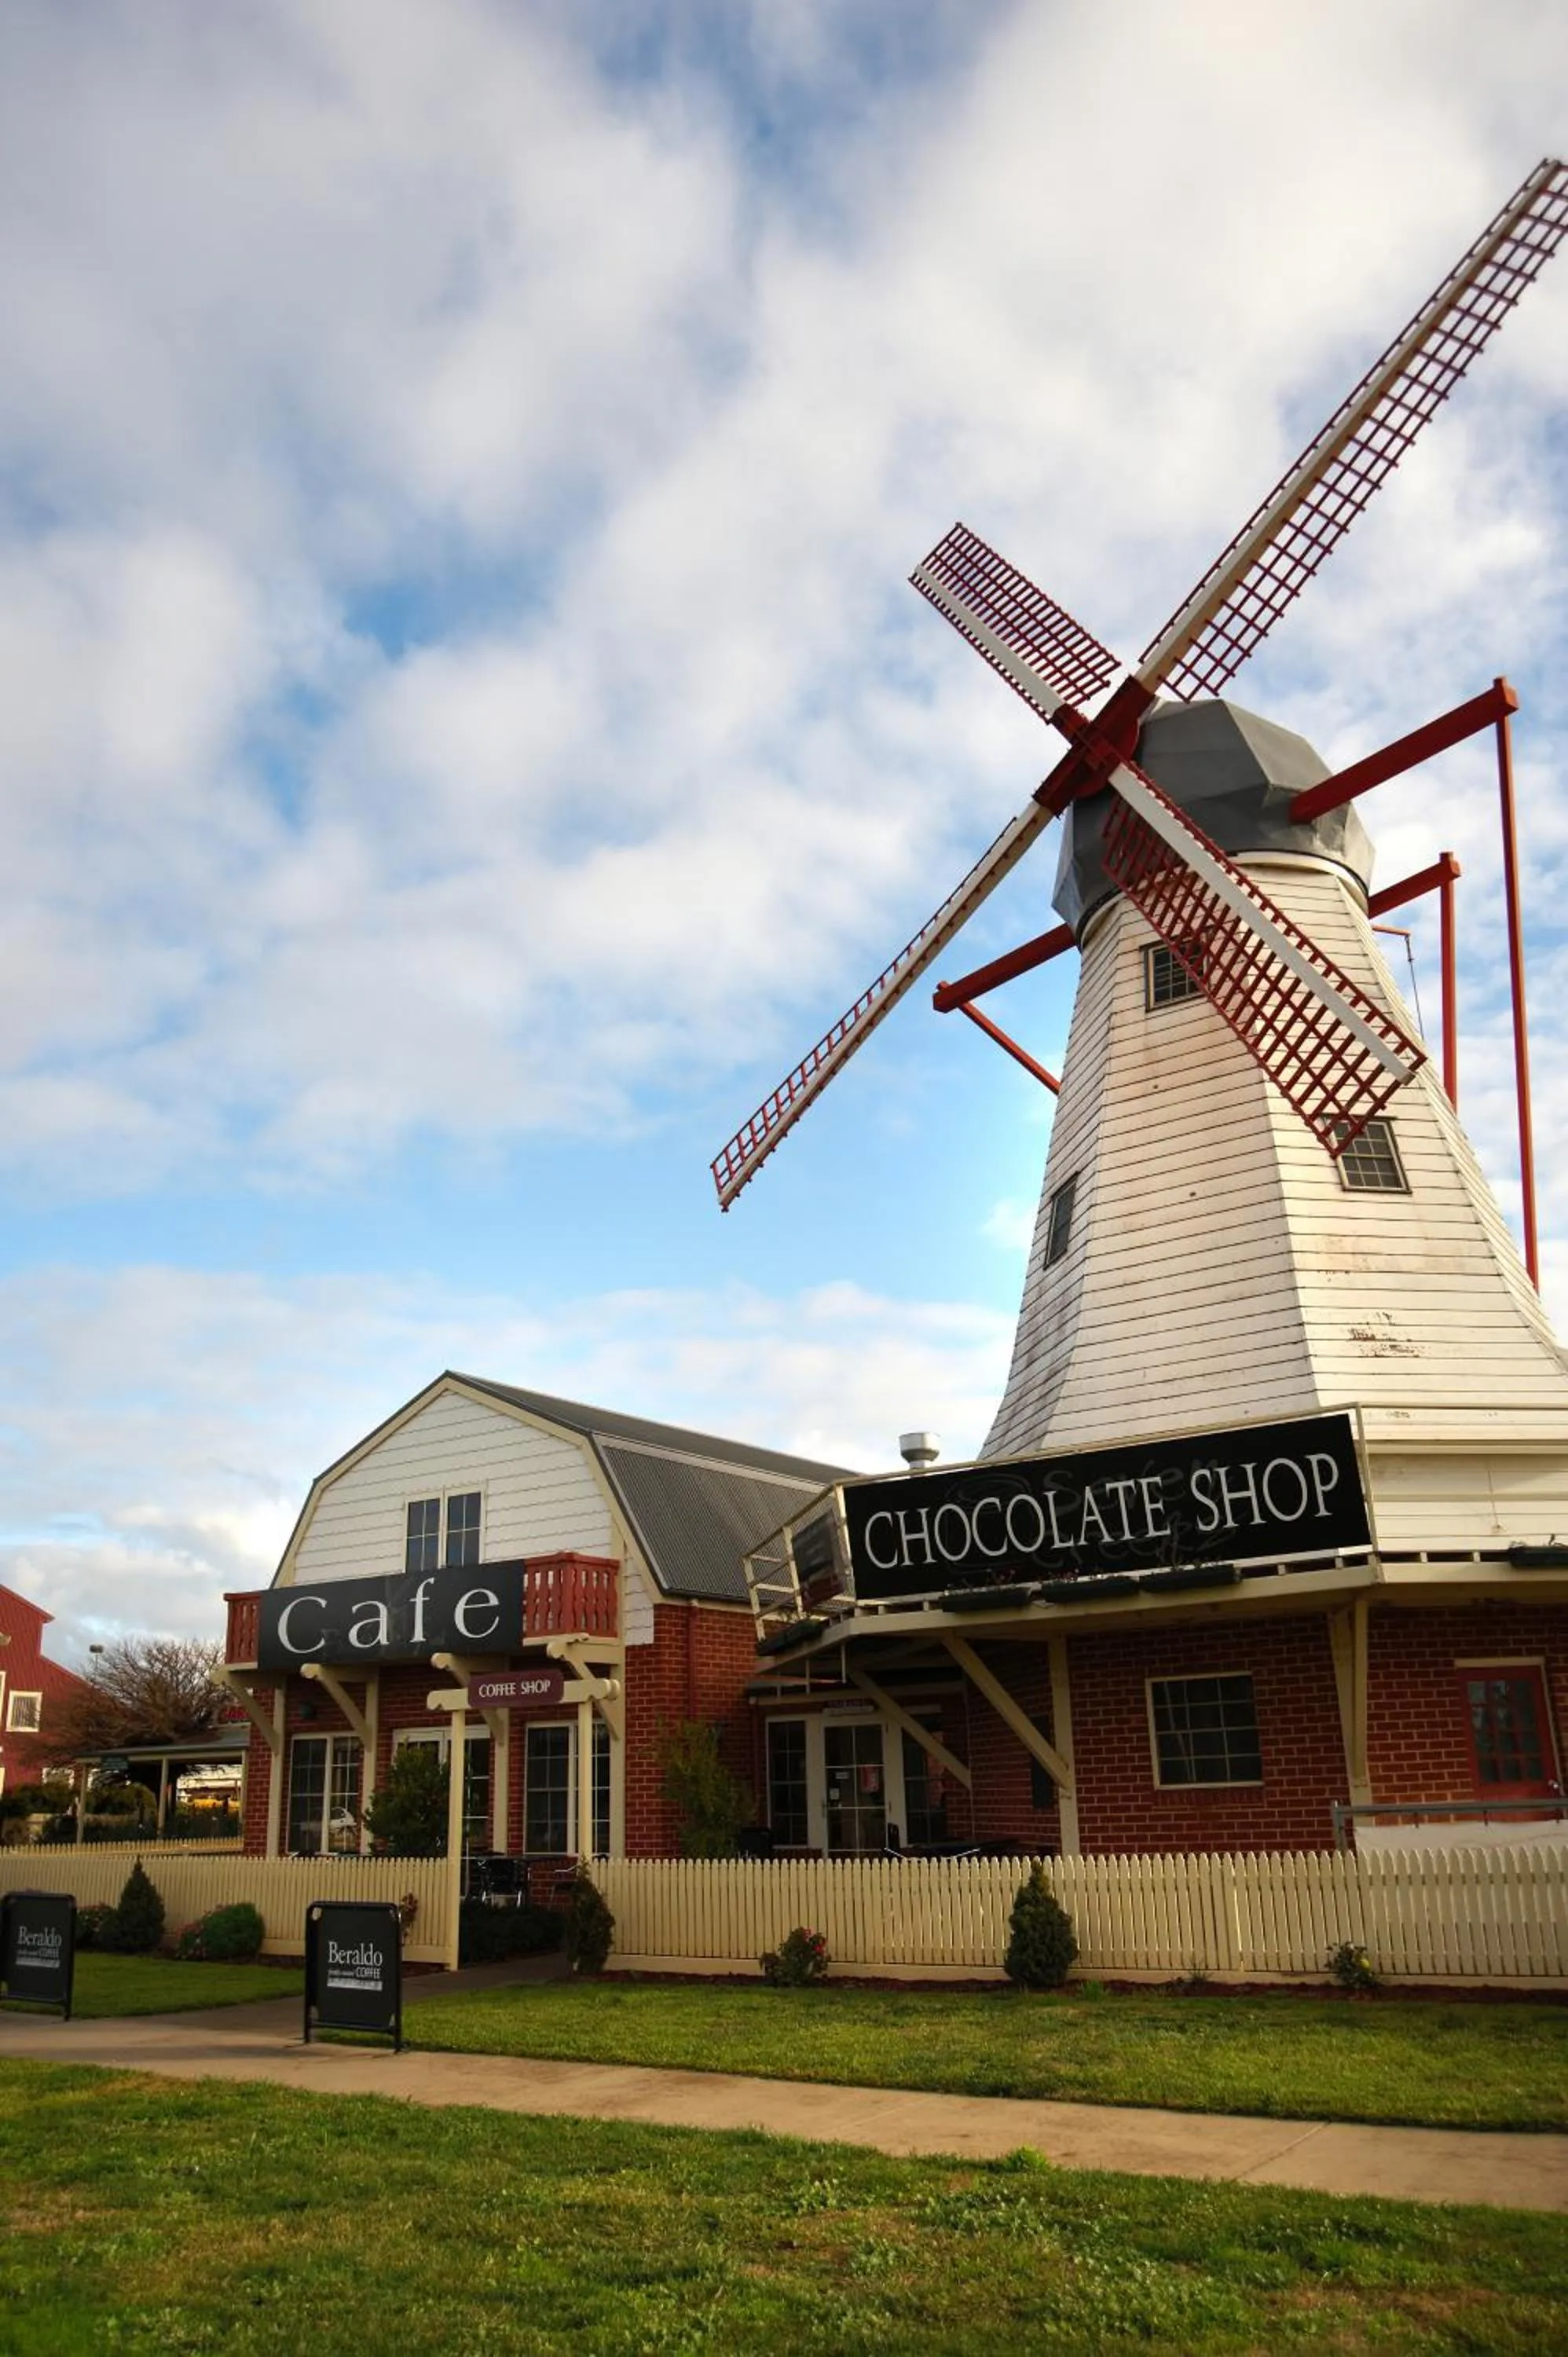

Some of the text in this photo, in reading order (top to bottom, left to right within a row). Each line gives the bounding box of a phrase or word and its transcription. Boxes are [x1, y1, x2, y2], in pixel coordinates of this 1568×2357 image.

[864, 1476, 1171, 1571] CHOCOLATE
[1189, 1451, 1339, 1533] SHOP
[277, 1576, 500, 1655] Cafe
[478, 1679, 551, 1698] COFFEE SHOP
[17, 1926, 62, 1947] Beraldo
[328, 1941, 383, 1967] Beraldo
[356, 1967, 381, 1979] COFFEE
